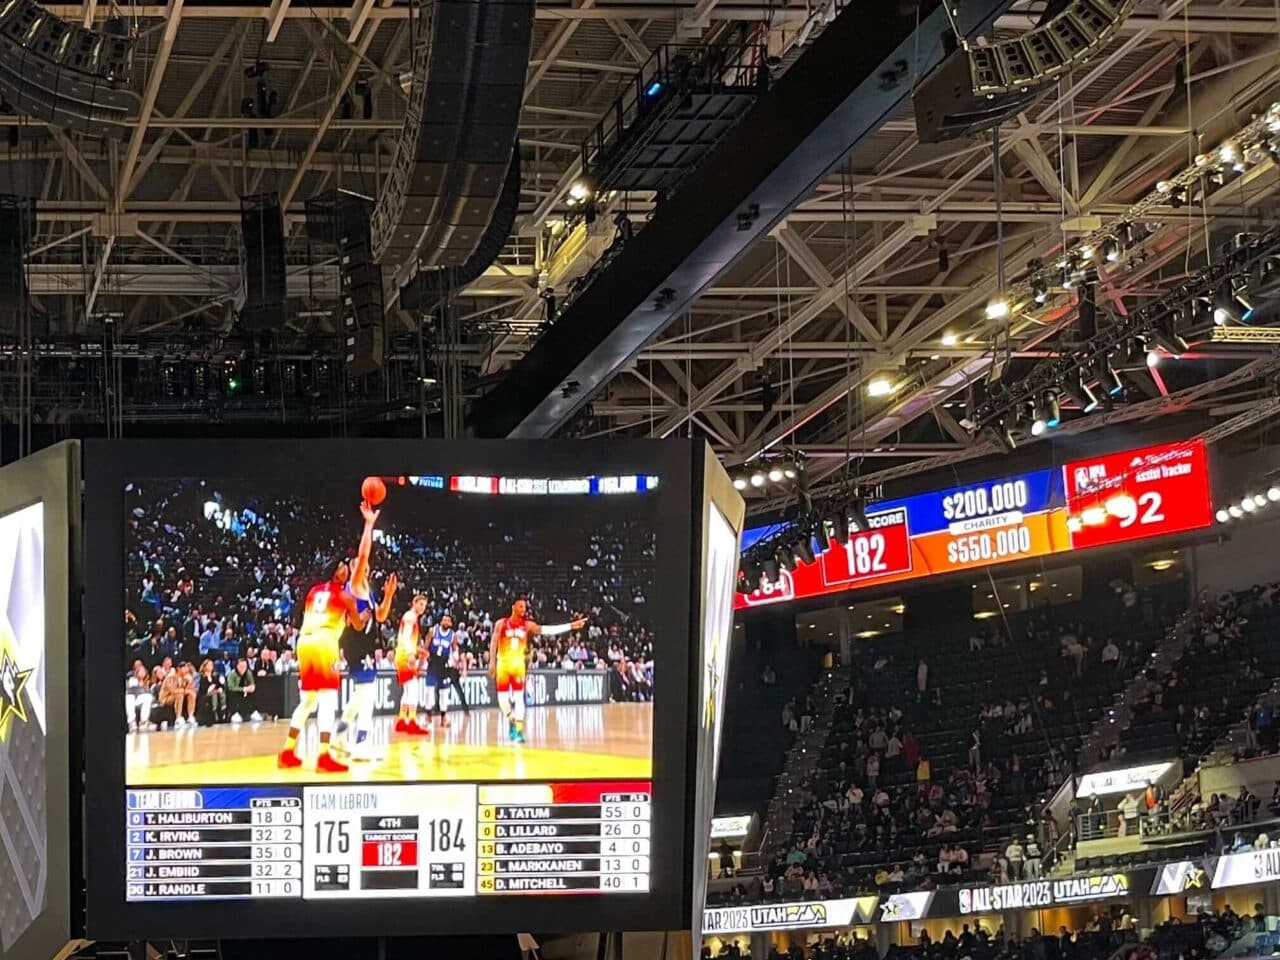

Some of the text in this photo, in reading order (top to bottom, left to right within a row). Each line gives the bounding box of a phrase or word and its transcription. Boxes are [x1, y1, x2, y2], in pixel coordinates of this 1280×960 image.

[943, 480, 1027, 520] $200,000
[964, 515, 1008, 532] CHARITY
[947, 527, 1030, 563] $550,000
[845, 533, 888, 576] 182
[555, 674, 603, 701] JOIN TODAY
[310, 794, 336, 810] TEAM
[132, 811, 292, 824] 0 T. HALIBURTON 18 0
[484, 806, 641, 819] 0 J. TATUM 55 0
[378, 818, 401, 828] 4TH
[133, 829, 292, 842] 2 K. IRVING 32 2
[314, 820, 350, 854] 175
[429, 818, 466, 852] 184
[484, 824, 640, 837] 0 D. LILLARD 26 0
[133, 847, 292, 860] 7 J. BROWN 35 0
[378, 843, 402, 866] 182
[481, 842, 640, 854] 13 B. ADEBAYO 4 0
[129, 865, 292, 878] 21 J. EMBIID 32 2
[480, 862, 494, 871] 23
[508, 860, 582, 872] MARKKANEN
[606, 860, 621, 871] 13
[632, 859, 640, 870] 0
[146, 885, 157, 895] J.
[159, 884, 206, 895] RANDLE
[257, 883, 271, 894] 11
[283, 882, 292, 894] 0
[480, 877, 639, 890] 45 D. MITCHELL 40 1
[1022, 879, 1089, 906] 2023 UTAH
[723, 908, 748, 929] 2023
[752, 907, 787, 924] UTAH
